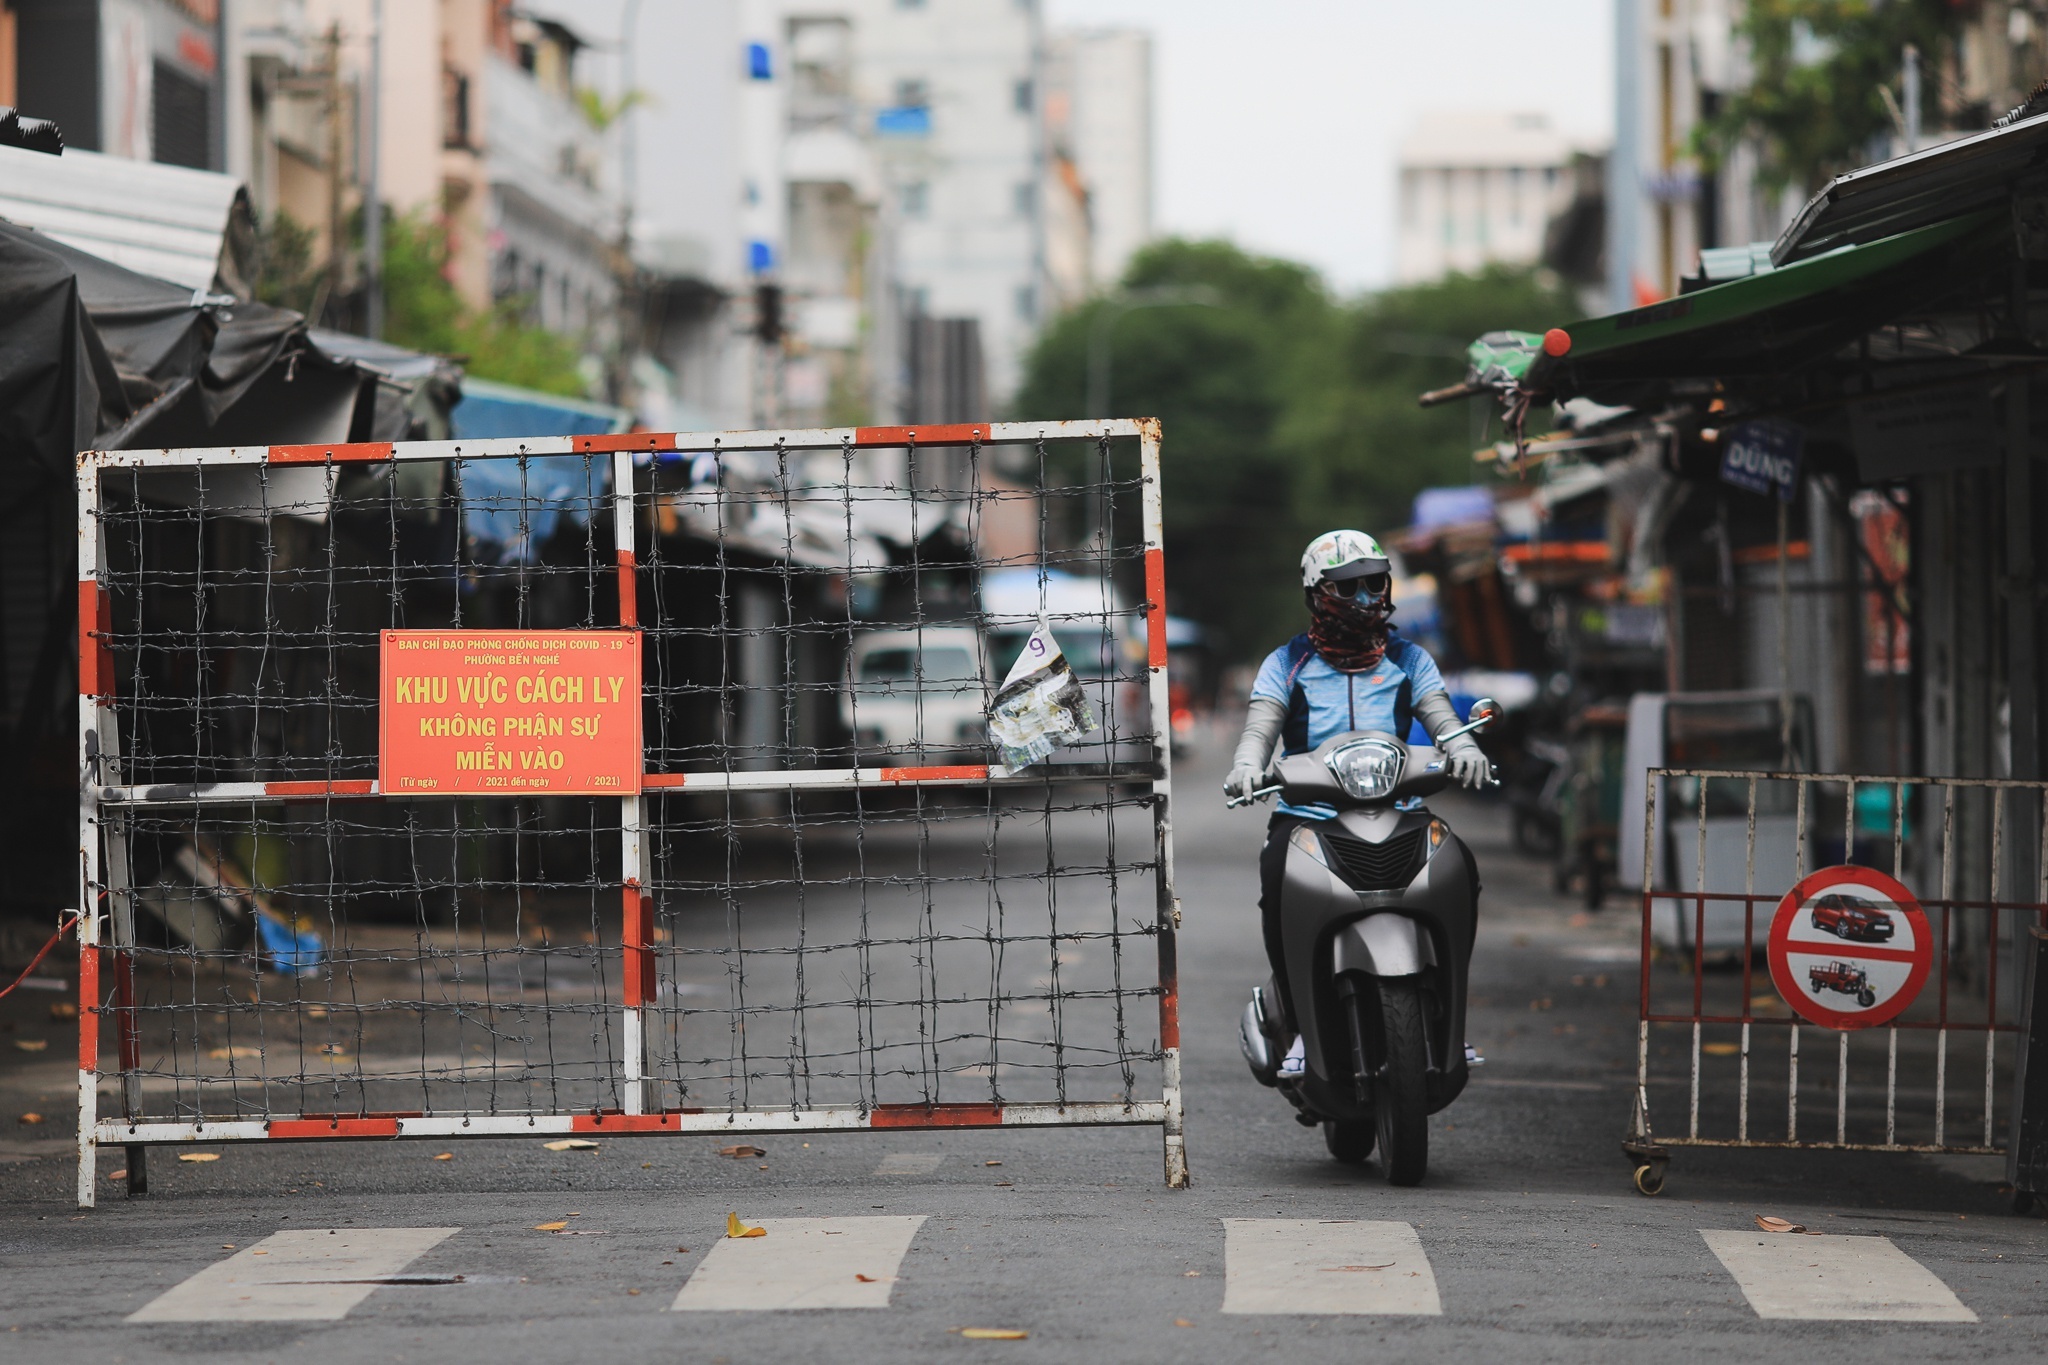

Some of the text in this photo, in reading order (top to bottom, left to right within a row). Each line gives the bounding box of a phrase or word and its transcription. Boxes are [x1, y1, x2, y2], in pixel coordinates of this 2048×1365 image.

[398, 640, 420, 650] BAN
[422, 637, 441, 650] CHỈ
[443, 640, 464, 651] ĐẠO
[467, 638, 502, 650] PHÒNG
[504, 636, 540, 650] CHỐNG
[542, 640, 566, 651] DỊCH
[569, 640, 600, 650] COVID
[610, 640, 623, 650] 19
[1029, 637, 1046, 658] 9
[464, 652, 560, 665] PHƯỜNG BẾN NGHÉ
[396, 669, 625, 709] KHU VỰC CÁCH LY
[420, 712, 602, 740] KHÔNG PHẬN SỰ
[456, 741, 565, 770] MIỄN VÀO
[400, 776, 416, 788] (Từ
[417, 777, 438, 789] ngày
[485, 776, 508, 787] 2021
[510, 775, 527, 786] đến
[529, 776, 550, 788] ngày
[594, 776, 620, 787] 2021)
